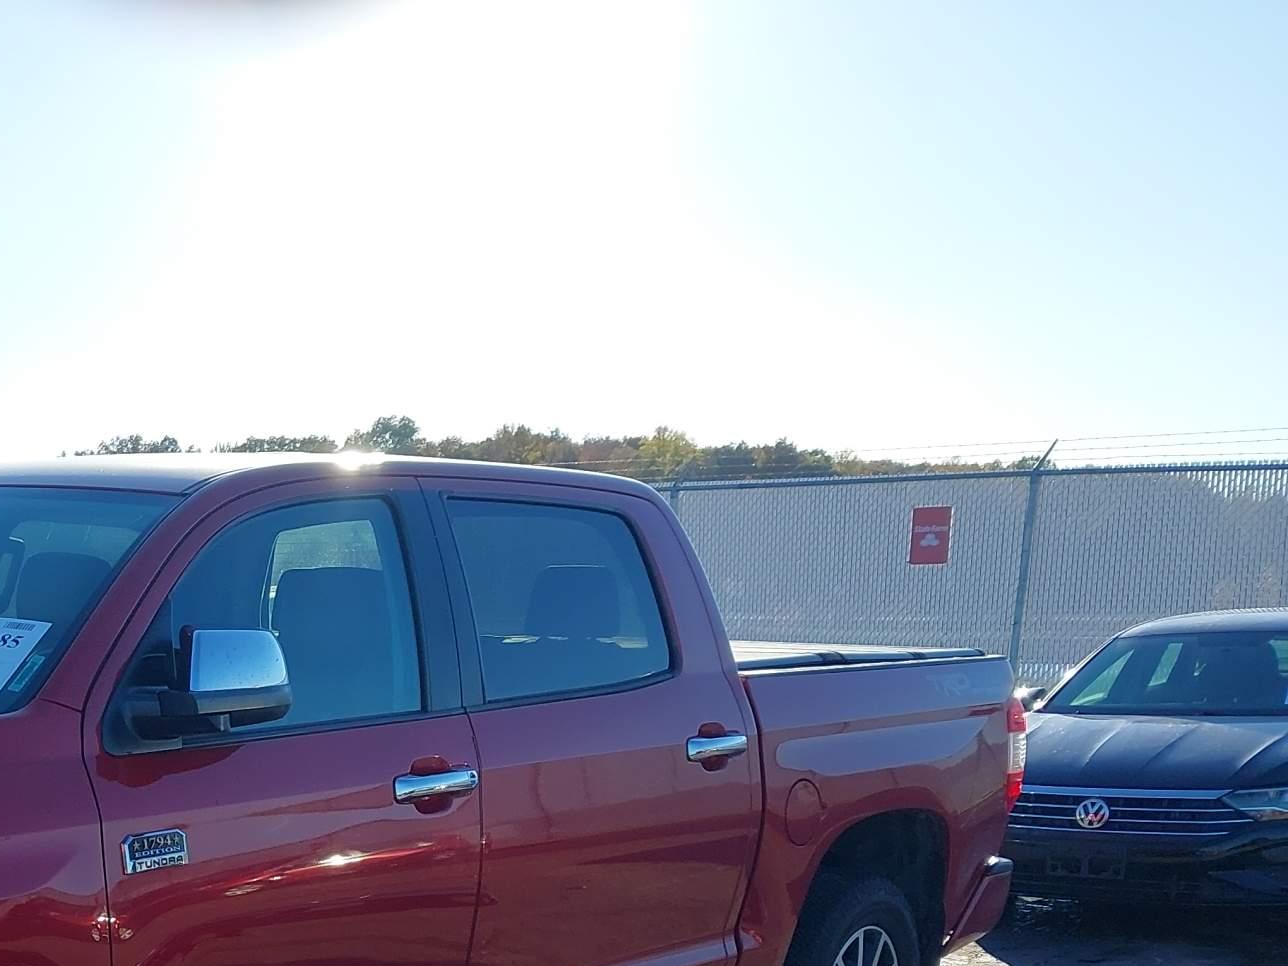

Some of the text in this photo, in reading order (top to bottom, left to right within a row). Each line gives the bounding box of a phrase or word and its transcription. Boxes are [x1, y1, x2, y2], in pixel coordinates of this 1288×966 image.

[143, 834, 172, 850] 1794
[135, 845, 182, 858] EDITION
[136, 855, 184, 871] TUNDRA
